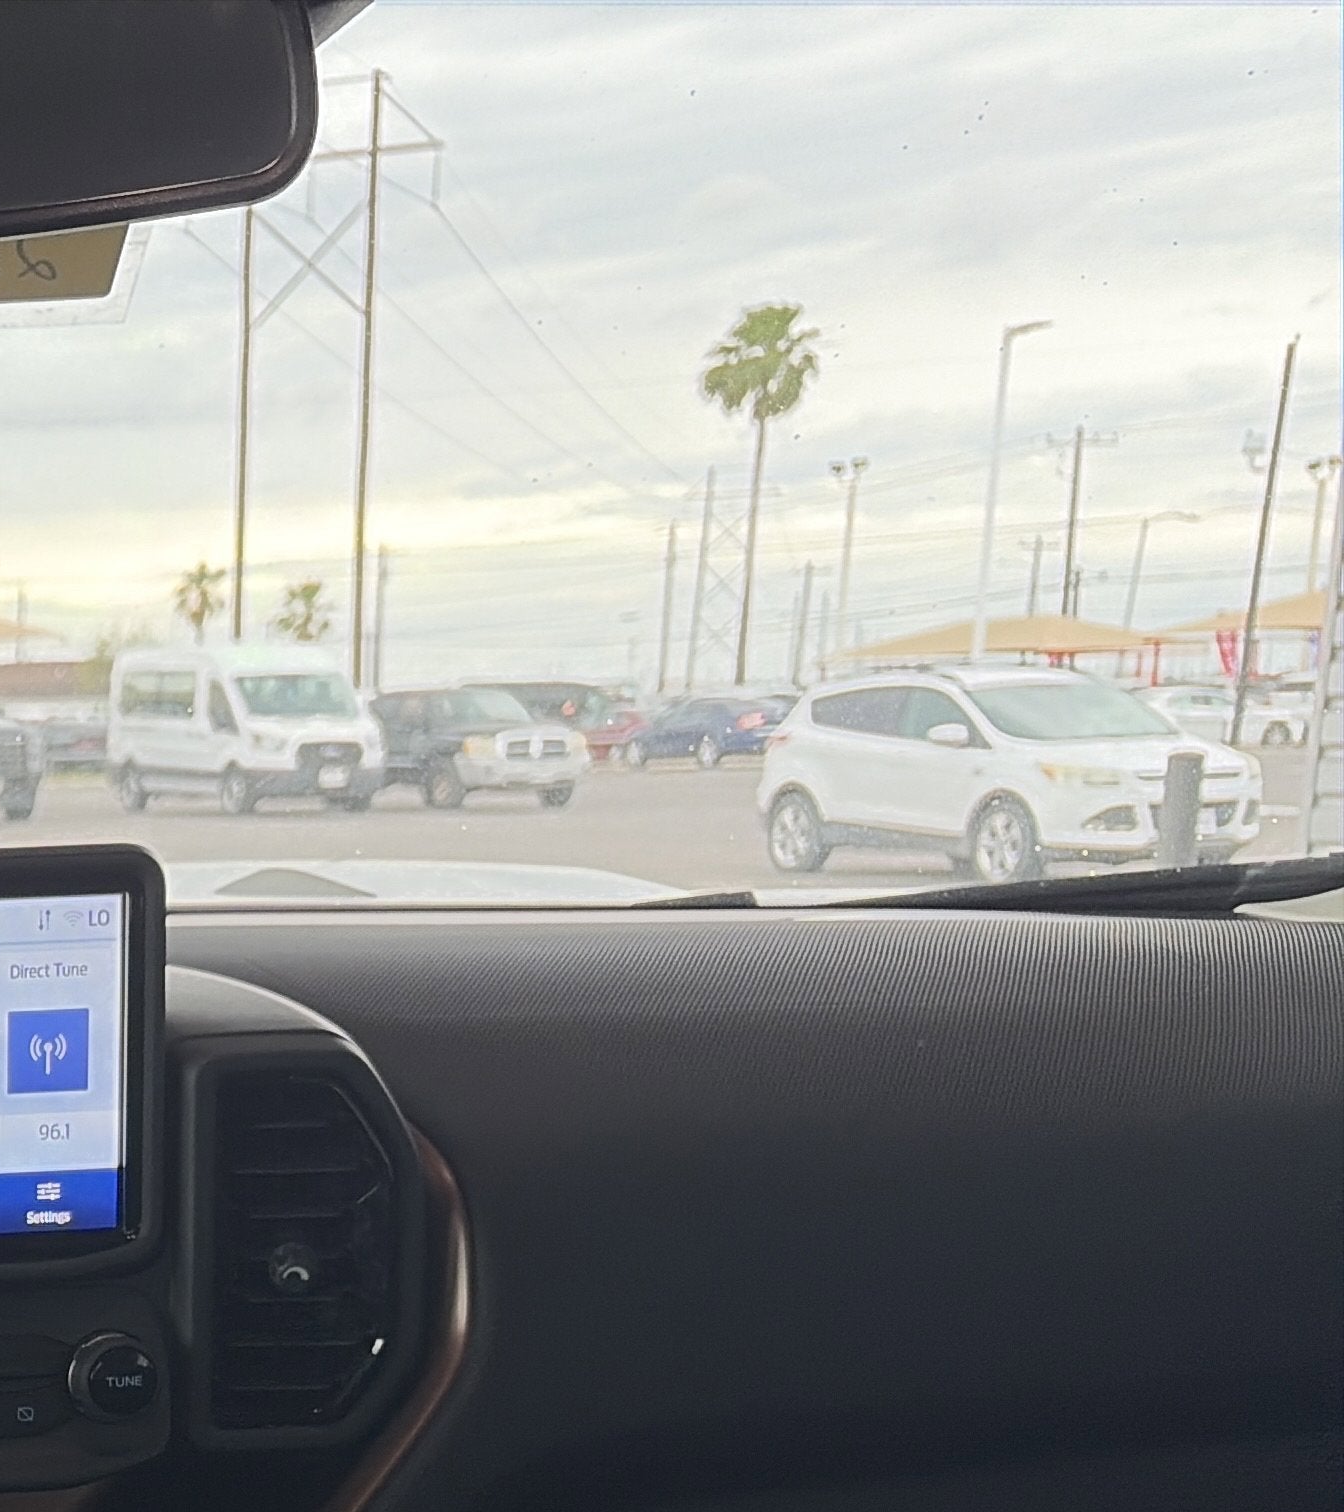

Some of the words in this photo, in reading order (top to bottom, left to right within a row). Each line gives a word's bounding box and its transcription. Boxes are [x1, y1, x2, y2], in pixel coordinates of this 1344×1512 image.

[88, 909, 110, 927] LO
[9, 964, 50, 980] Direct
[53, 962, 88, 977] Tune
[38, 1123, 70, 1140] 96.1
[26, 1210, 71, 1225] Settings
[106, 1375, 143, 1388] TUNE
